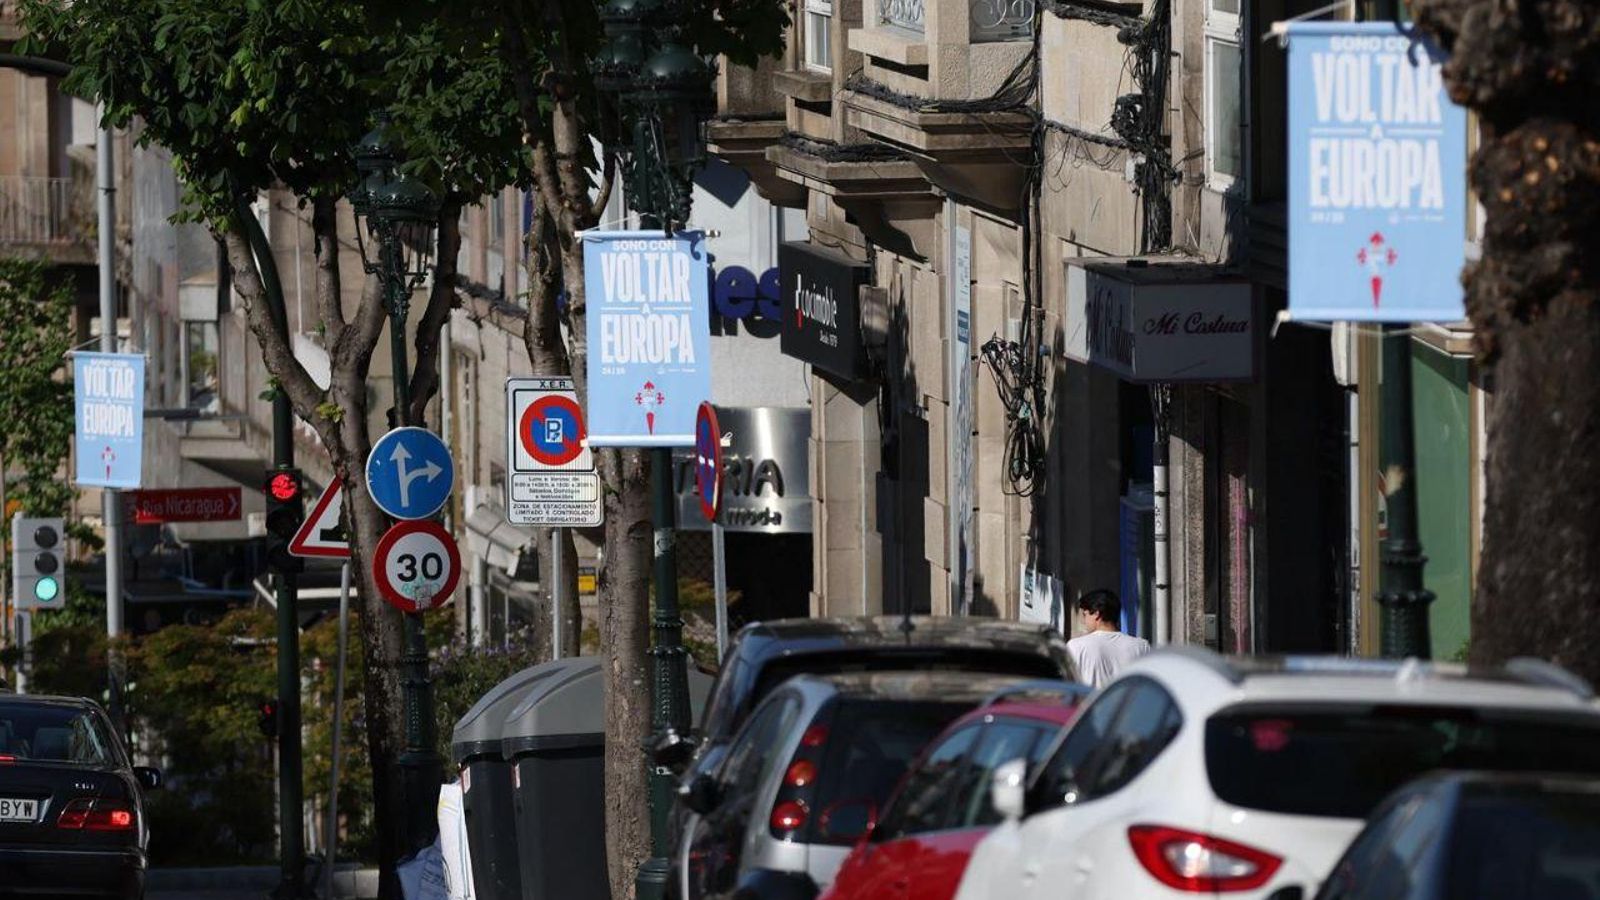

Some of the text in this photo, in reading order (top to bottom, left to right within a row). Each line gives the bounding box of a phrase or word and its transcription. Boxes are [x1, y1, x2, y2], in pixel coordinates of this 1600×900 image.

[1312, 53, 1442, 123] VOLTAR
[1371, 124, 1384, 139] A
[1310, 138, 1443, 209] EUROPA
[649, 240, 677, 251] CON
[600, 253, 692, 302] VOLTAR
[641, 303, 651, 314] A
[1144, 311, 1249, 335] Mi Costura
[601, 314, 696, 364] EUROPA
[83, 366, 135, 399] VOLTAR
[83, 402, 135, 437] EUROPA
[165, 496, 225, 518] Nicaragua
[727, 507, 782, 526] moda
[397, 552, 443, 582] 30
[0, 801, 33, 817] BYW
